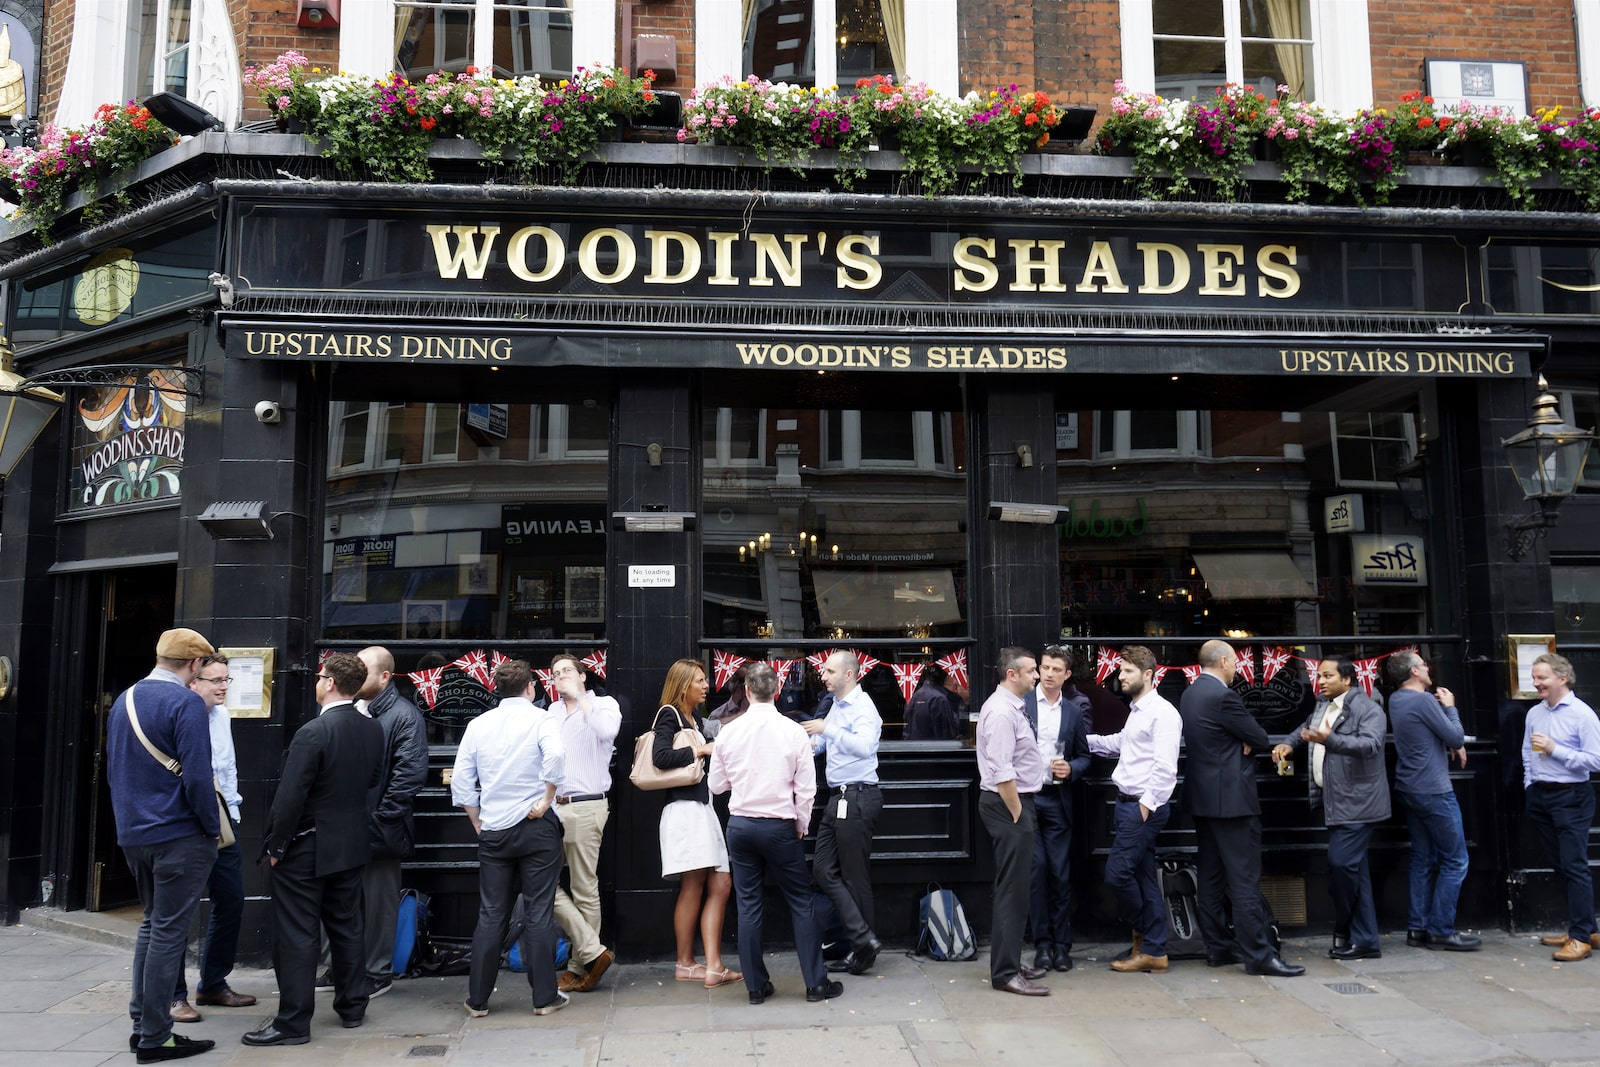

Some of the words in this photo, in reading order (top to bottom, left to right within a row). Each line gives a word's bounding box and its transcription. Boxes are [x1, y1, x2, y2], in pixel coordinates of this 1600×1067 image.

[426, 226, 884, 290] WOODIN'S
[952, 237, 1302, 298] SHADES
[245, 331, 392, 358] UPSTAIRS
[400, 335, 513, 360] DINING
[736, 344, 911, 367] WOODIN'S
[926, 346, 1067, 369] SHADES
[1279, 350, 1409, 373] UPSTAIRS
[1417, 352, 1514, 375] DINING
